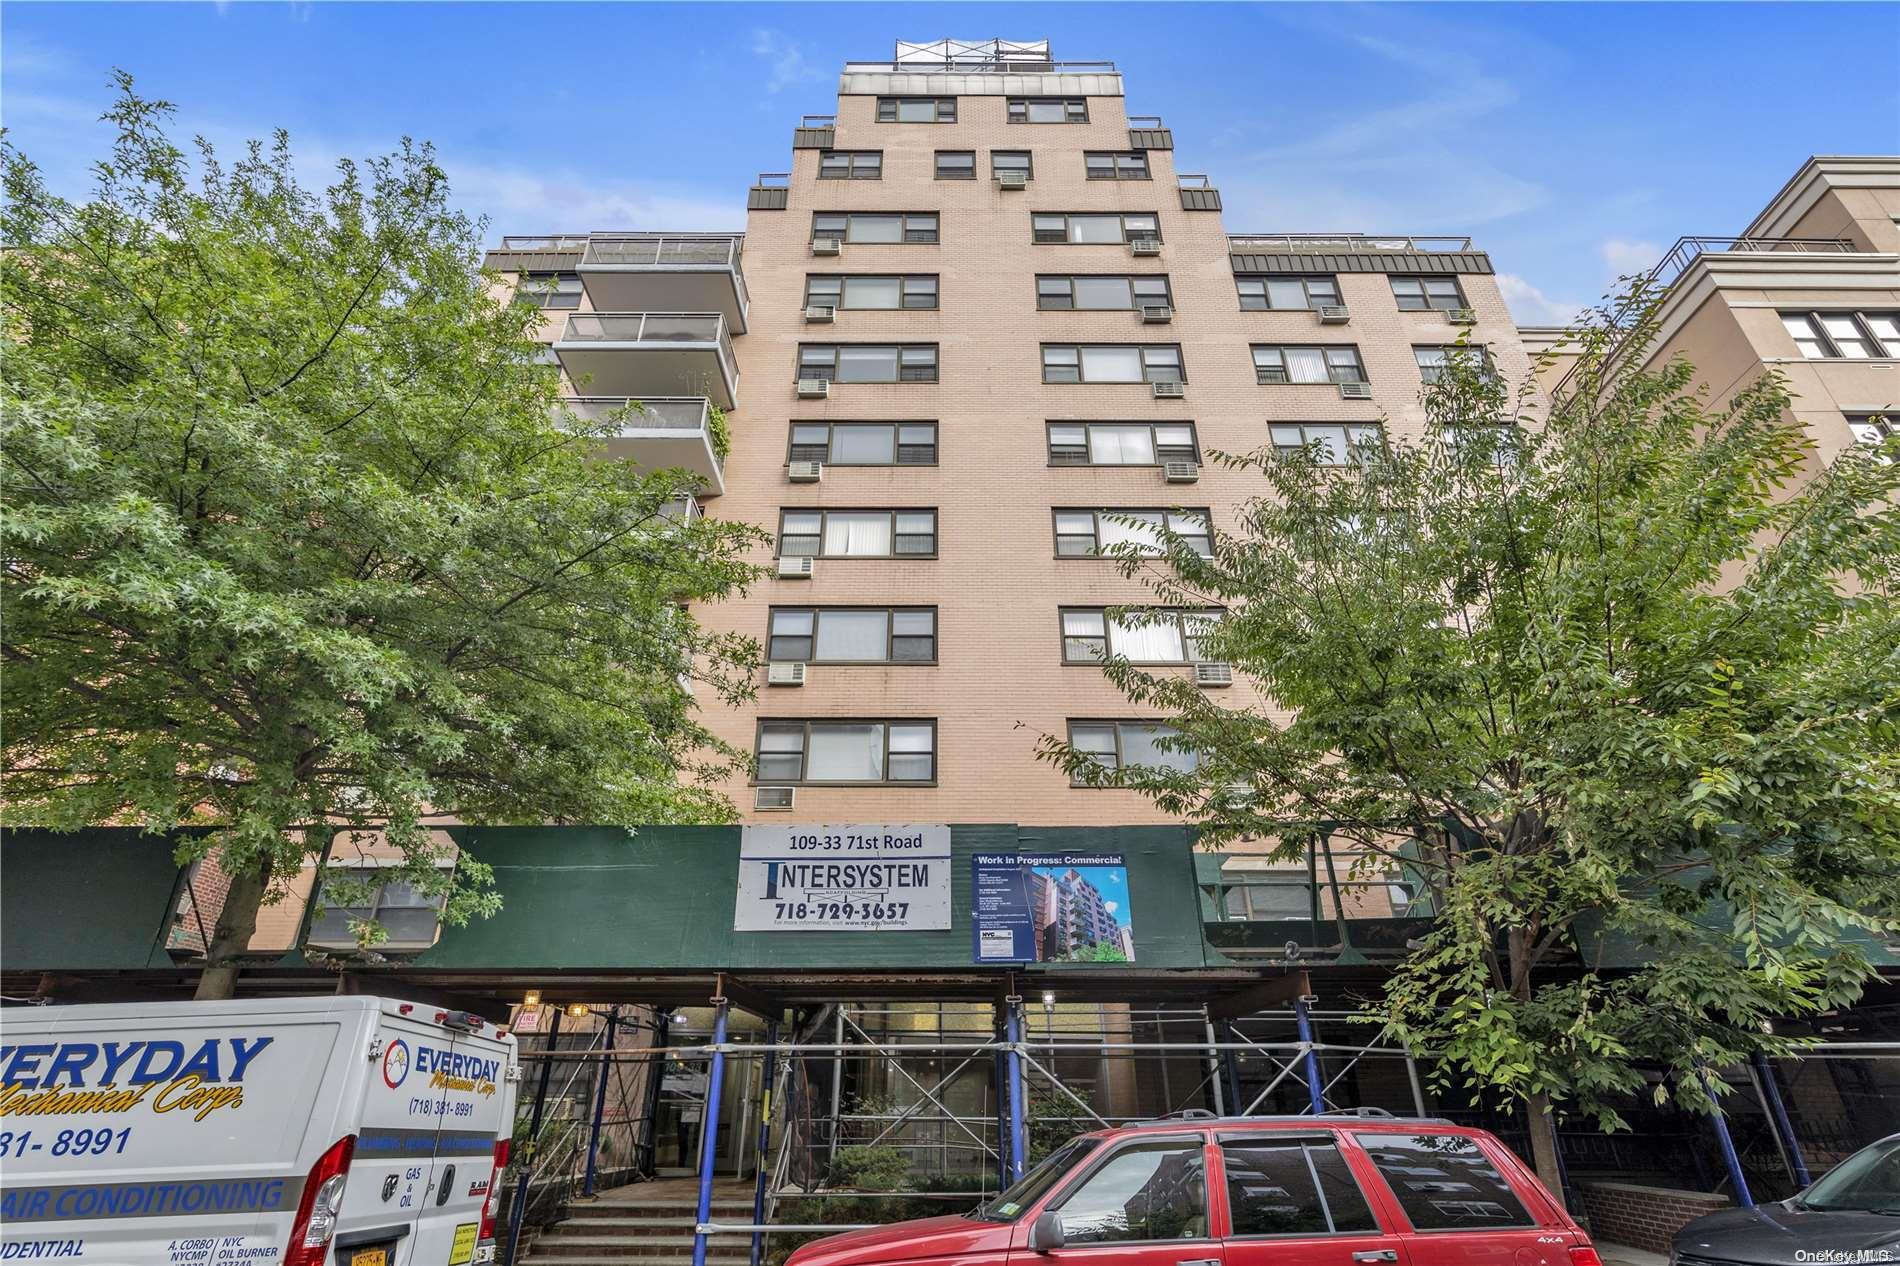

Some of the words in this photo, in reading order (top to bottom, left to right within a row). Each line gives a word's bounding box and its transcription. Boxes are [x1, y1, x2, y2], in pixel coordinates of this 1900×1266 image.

[790, 835, 841, 850] 109-33
[847, 835, 879, 850] 71st
[884, 833, 923, 849] Road
[978, 856, 1003, 865] Work
[1005, 856, 1014, 864] in
[1017, 856, 1062, 866] Progress:
[1064, 856, 1122, 865] Commercial
[760, 861, 929, 900] INTERSYSTEM
[775, 902, 909, 920] 718-729-3657
[415, 1046, 500, 1083] EVERYDAY
[153, 1074, 243, 1123] Corp.
[408, 1097, 433, 1116] (718)
[51, 1127, 132, 1157] 8991
[406, 1167, 421, 1180] GAS
[0, 1189, 50, 1218] AIR
[55, 1180, 284, 1217] CONDITIONING
[400, 1195, 412, 1208] OIL
[180, 1239, 215, 1250] CORBO
[222, 1237, 245, 1247] NYC
[170, 1250, 208, 1262] NYCMP
[218, 1249, 235, 1259] OIL
[236, 1247, 279, 1259] BURNER
